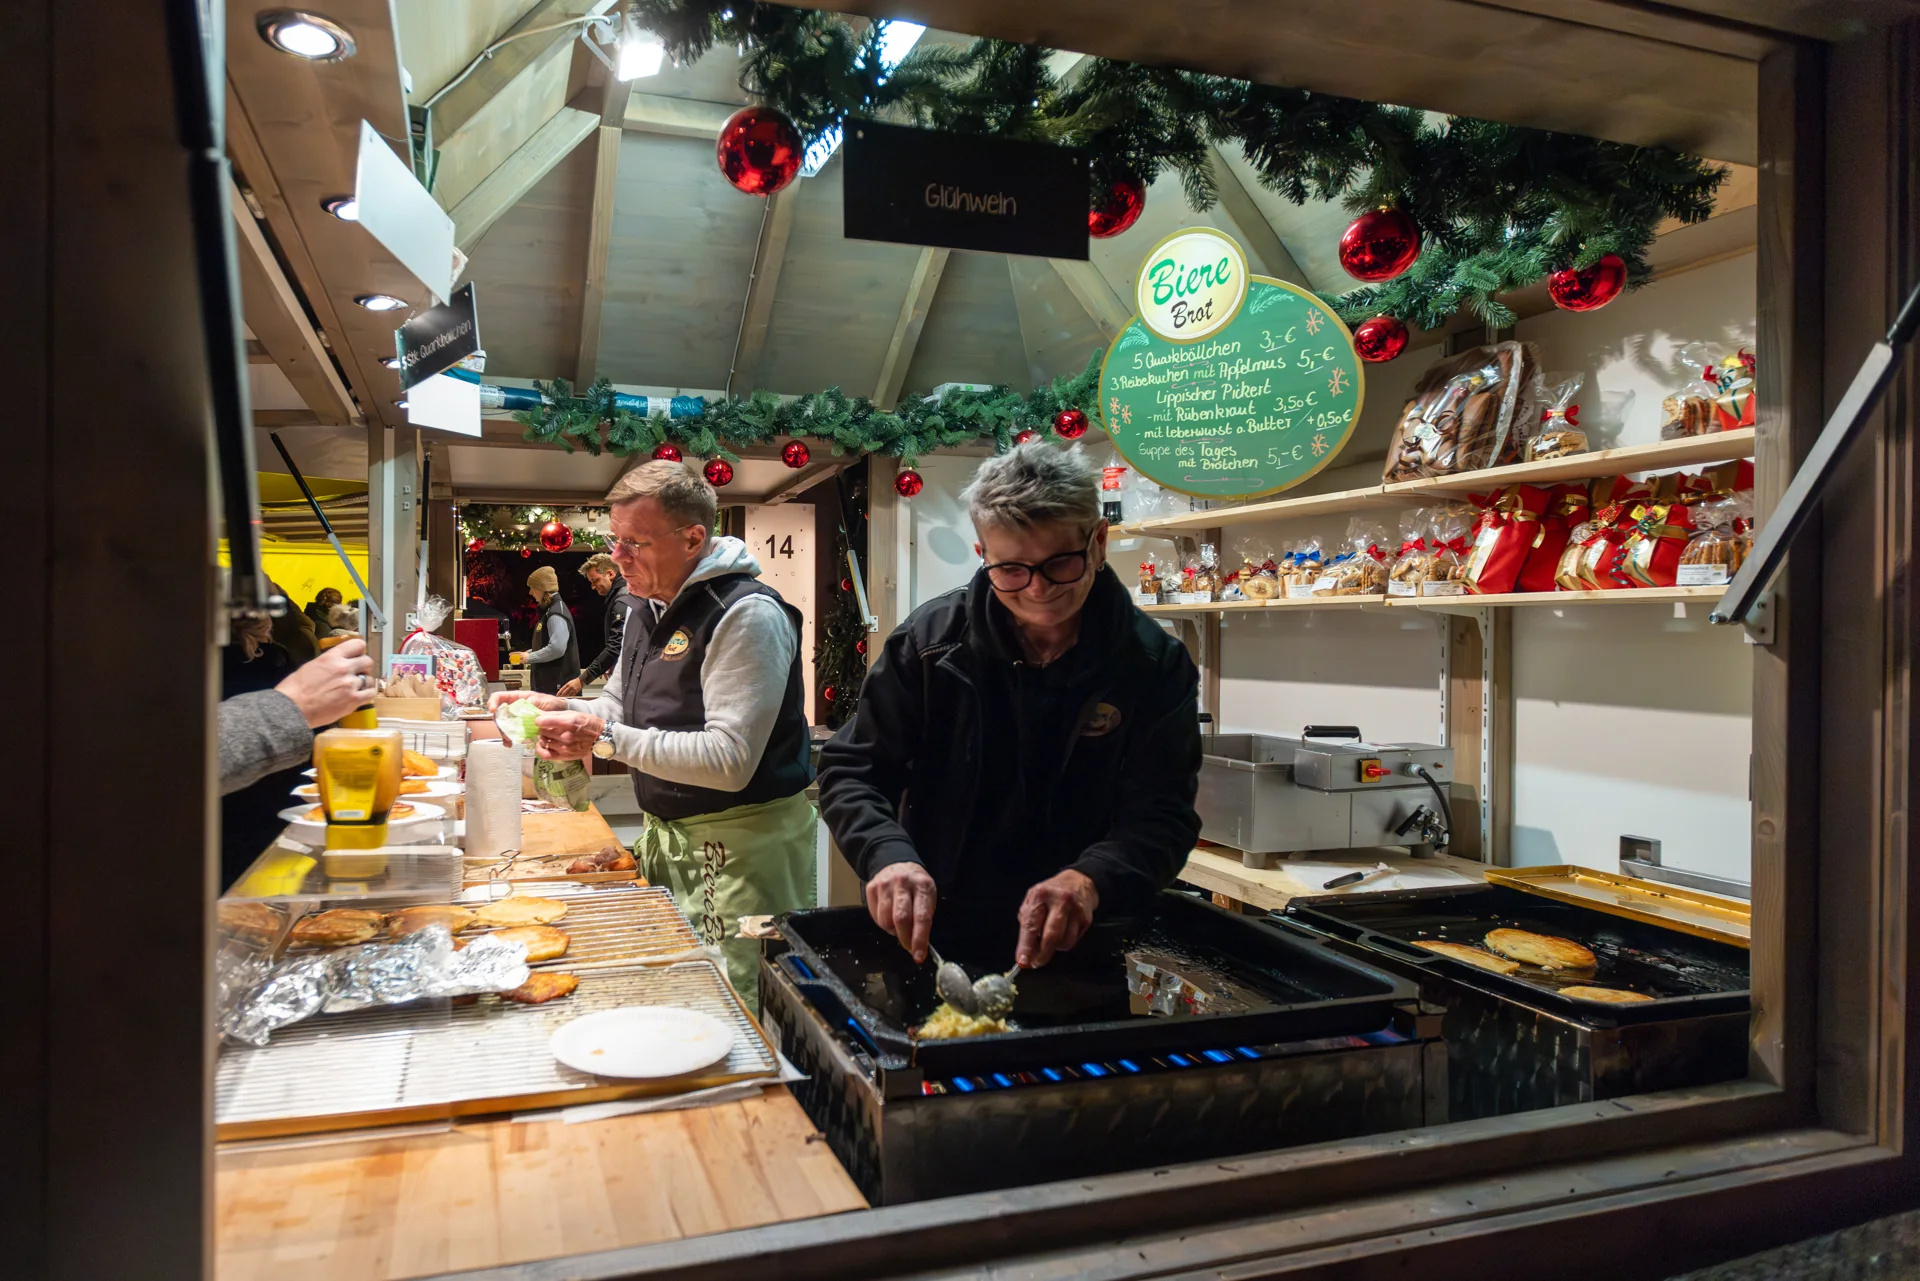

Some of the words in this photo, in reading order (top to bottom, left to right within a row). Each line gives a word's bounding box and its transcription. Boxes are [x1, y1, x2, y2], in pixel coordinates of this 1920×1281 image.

[1148, 257, 1231, 305] Biere
[1170, 298, 1214, 329] Brot
[1132, 353, 1143, 370] 5
[1145, 341, 1241, 369] Quarkbällchen
[1110, 377, 1120, 391] 3
[1120, 368, 1189, 389] Reibekuchen
[1193, 364, 1216, 379] mit
[1218, 357, 1287, 381] Apfelmus
[1156, 387, 1217, 408] Lippischer
[1221, 378, 1272, 400] Pickert
[1176, 400, 1257, 422] Rübenkraut
[1144, 425, 1164, 439] mit
[1246, 415, 1292, 434] Butter
[1138, 442, 1171, 460] Suppe
[1174, 443, 1195, 456] des
[1197, 441, 1237, 461] Tages
[1178, 458, 1197, 468] mit
[1200, 457, 1259, 470] Brötchen
[765, 534, 794, 559] 14
